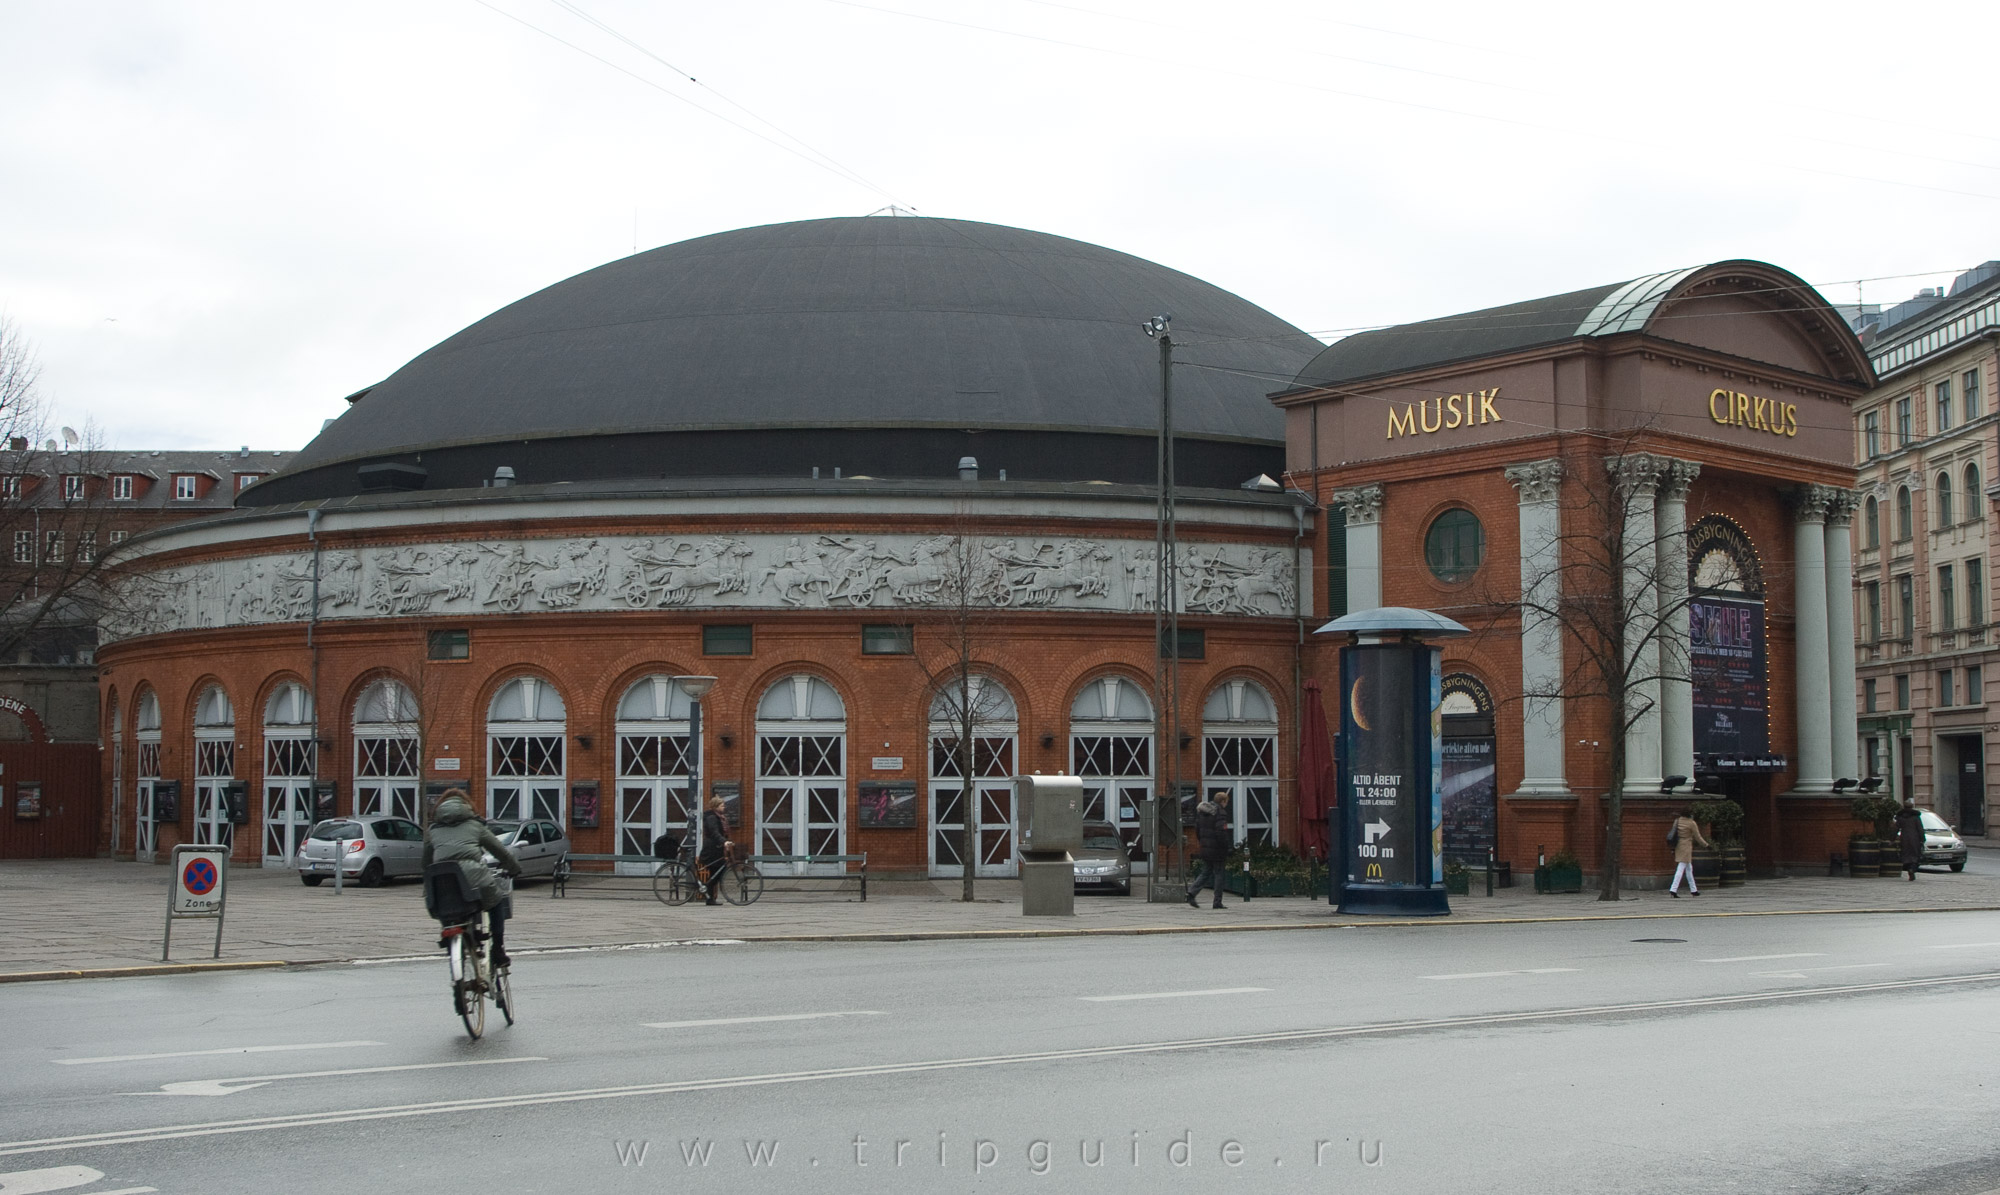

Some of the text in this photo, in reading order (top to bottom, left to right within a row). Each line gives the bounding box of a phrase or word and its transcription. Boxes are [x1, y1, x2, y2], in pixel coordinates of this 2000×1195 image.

[1386, 387, 1502, 440] MUSIK
[1709, 388, 1798, 437] CIRKUS
[1690, 603, 1752, 648] SMILE
[1353, 773, 1401, 786] ALTID ÅBENT
[1356, 787, 1396, 798] TIL 24:00
[1358, 844, 1394, 858] 100 m
[185, 899, 212, 908] Zone
